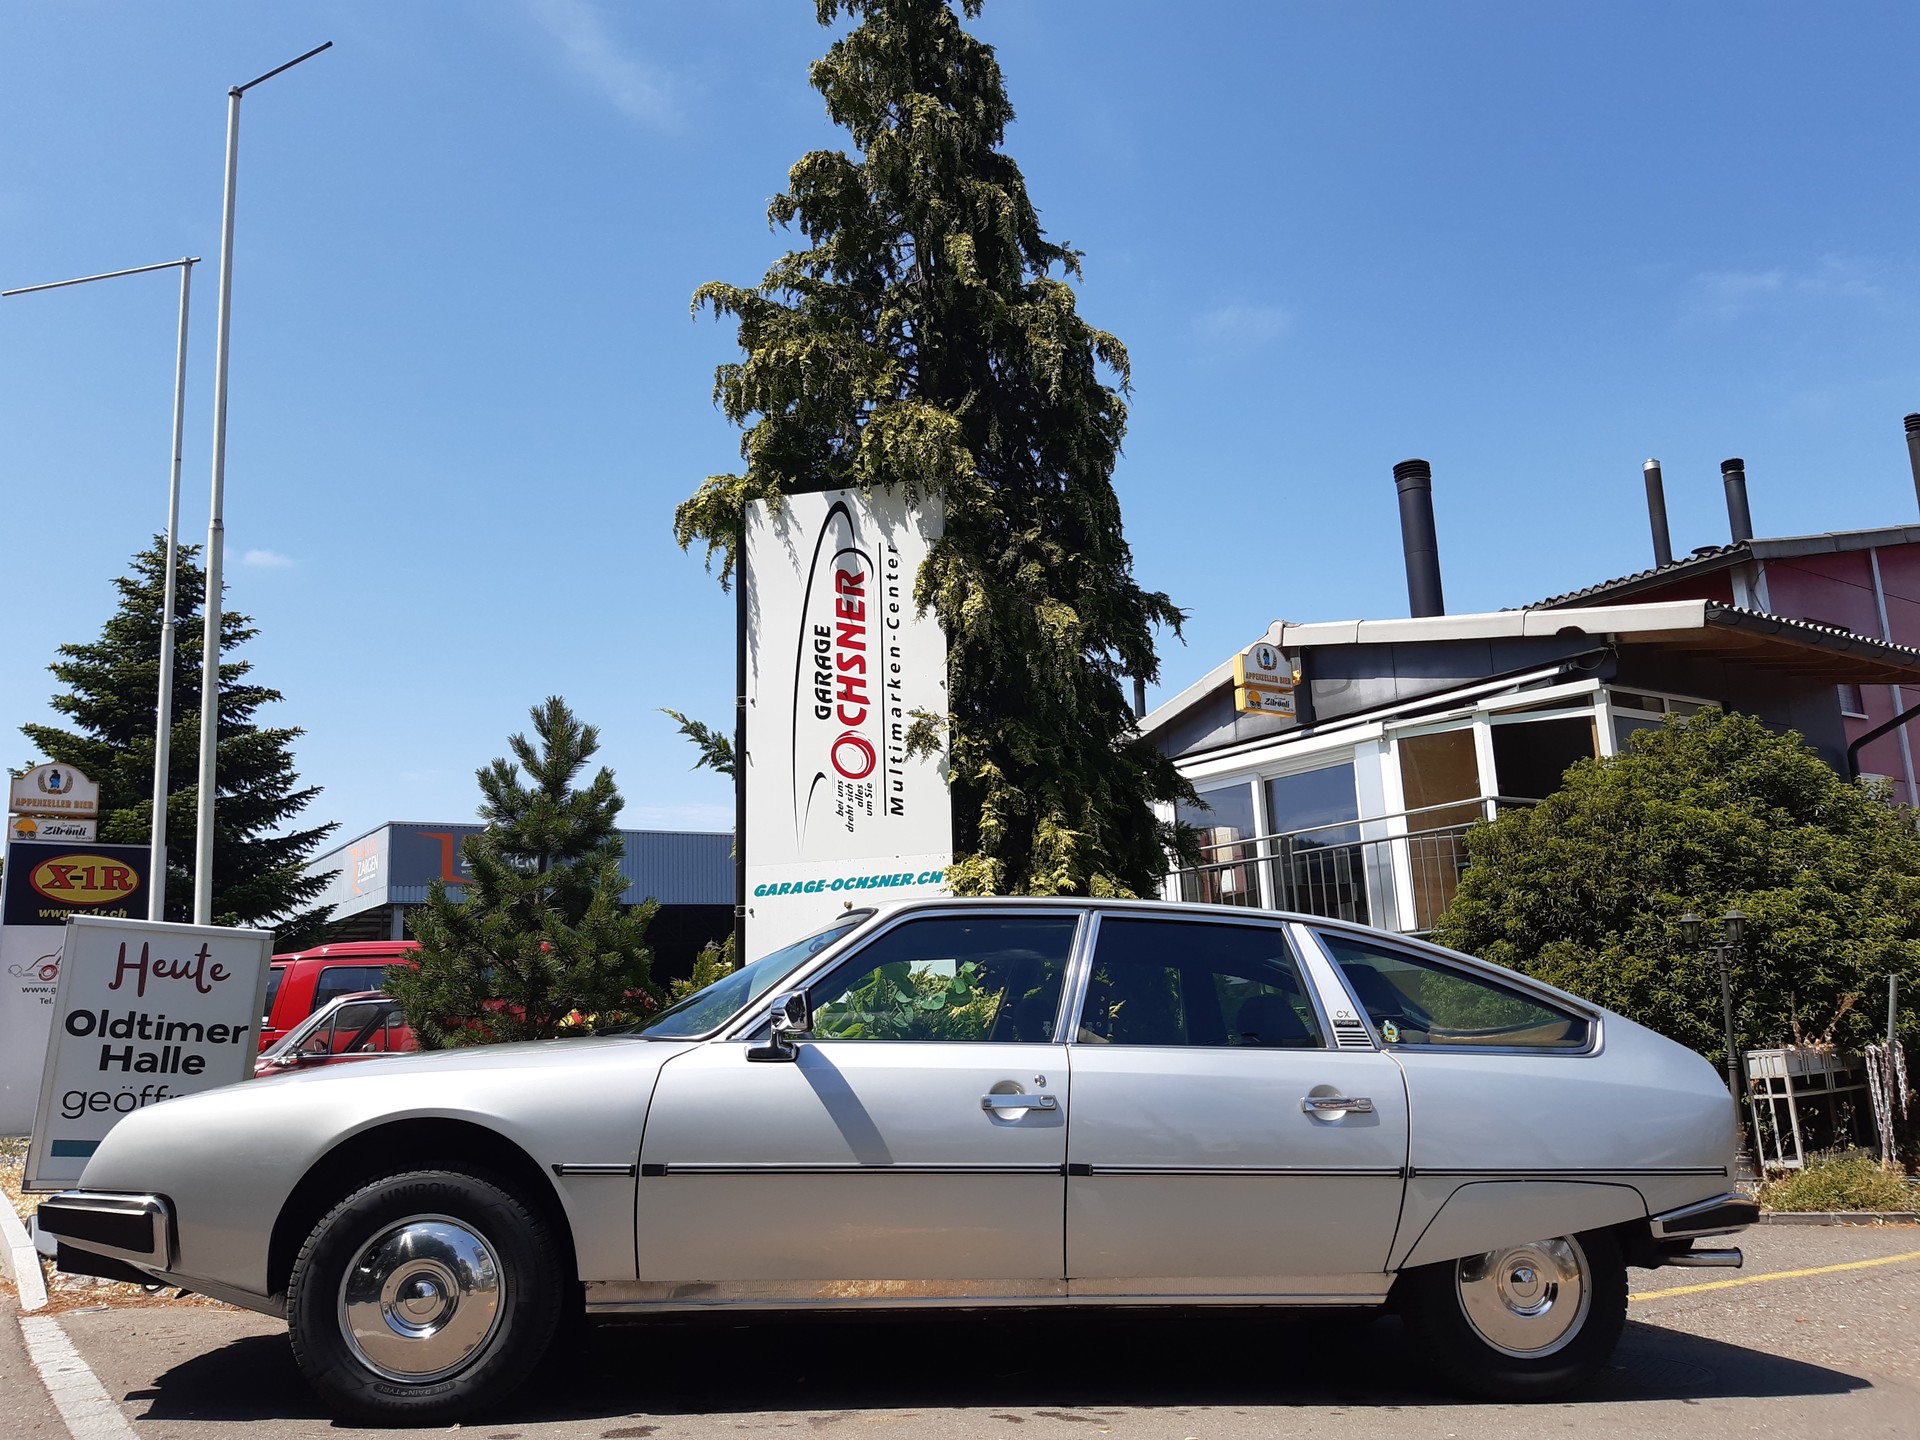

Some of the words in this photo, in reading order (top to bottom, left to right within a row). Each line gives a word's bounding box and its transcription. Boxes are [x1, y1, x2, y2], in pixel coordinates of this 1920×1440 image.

[814, 625, 832, 720] GARAGE
[886, 544, 905, 816] Multimarken-Center
[1245, 672, 1279, 683] APPENZELLER
[1279, 676, 1291, 685] BIER
[1264, 697, 1290, 708] Zitrönli
[845, 783, 854, 803] sich
[854, 784, 864, 808] alles
[864, 782, 873, 798] Sie
[15, 798, 72, 809] APPENZELLER
[73, 800, 94, 810] BIER
[835, 799, 844, 817] bei
[866, 800, 873, 816] um
[845, 804, 854, 833] dreht
[42, 826, 87, 836] Zitrönli
[41, 864, 134, 892] X-1R
[753, 871, 945, 897] GARAGE-OCHSNER.CH
[38, 907, 128, 918] wwwx-1r.ch
[108, 941, 231, 997] Heute
[21, 986, 57, 995] www.g
[39, 997, 54, 1005] Tel.
[1336, 1010, 1350, 1018] CX
[65, 1009, 250, 1045] Oldtimer
[99, 1044, 206, 1075] Halle
[61, 1084, 186, 1120] geöff
[380, 1182, 470, 1200] UNIROYAL
[379, 1384, 400, 1396] TYRE
[409, 1388, 432, 1396] RAIN
